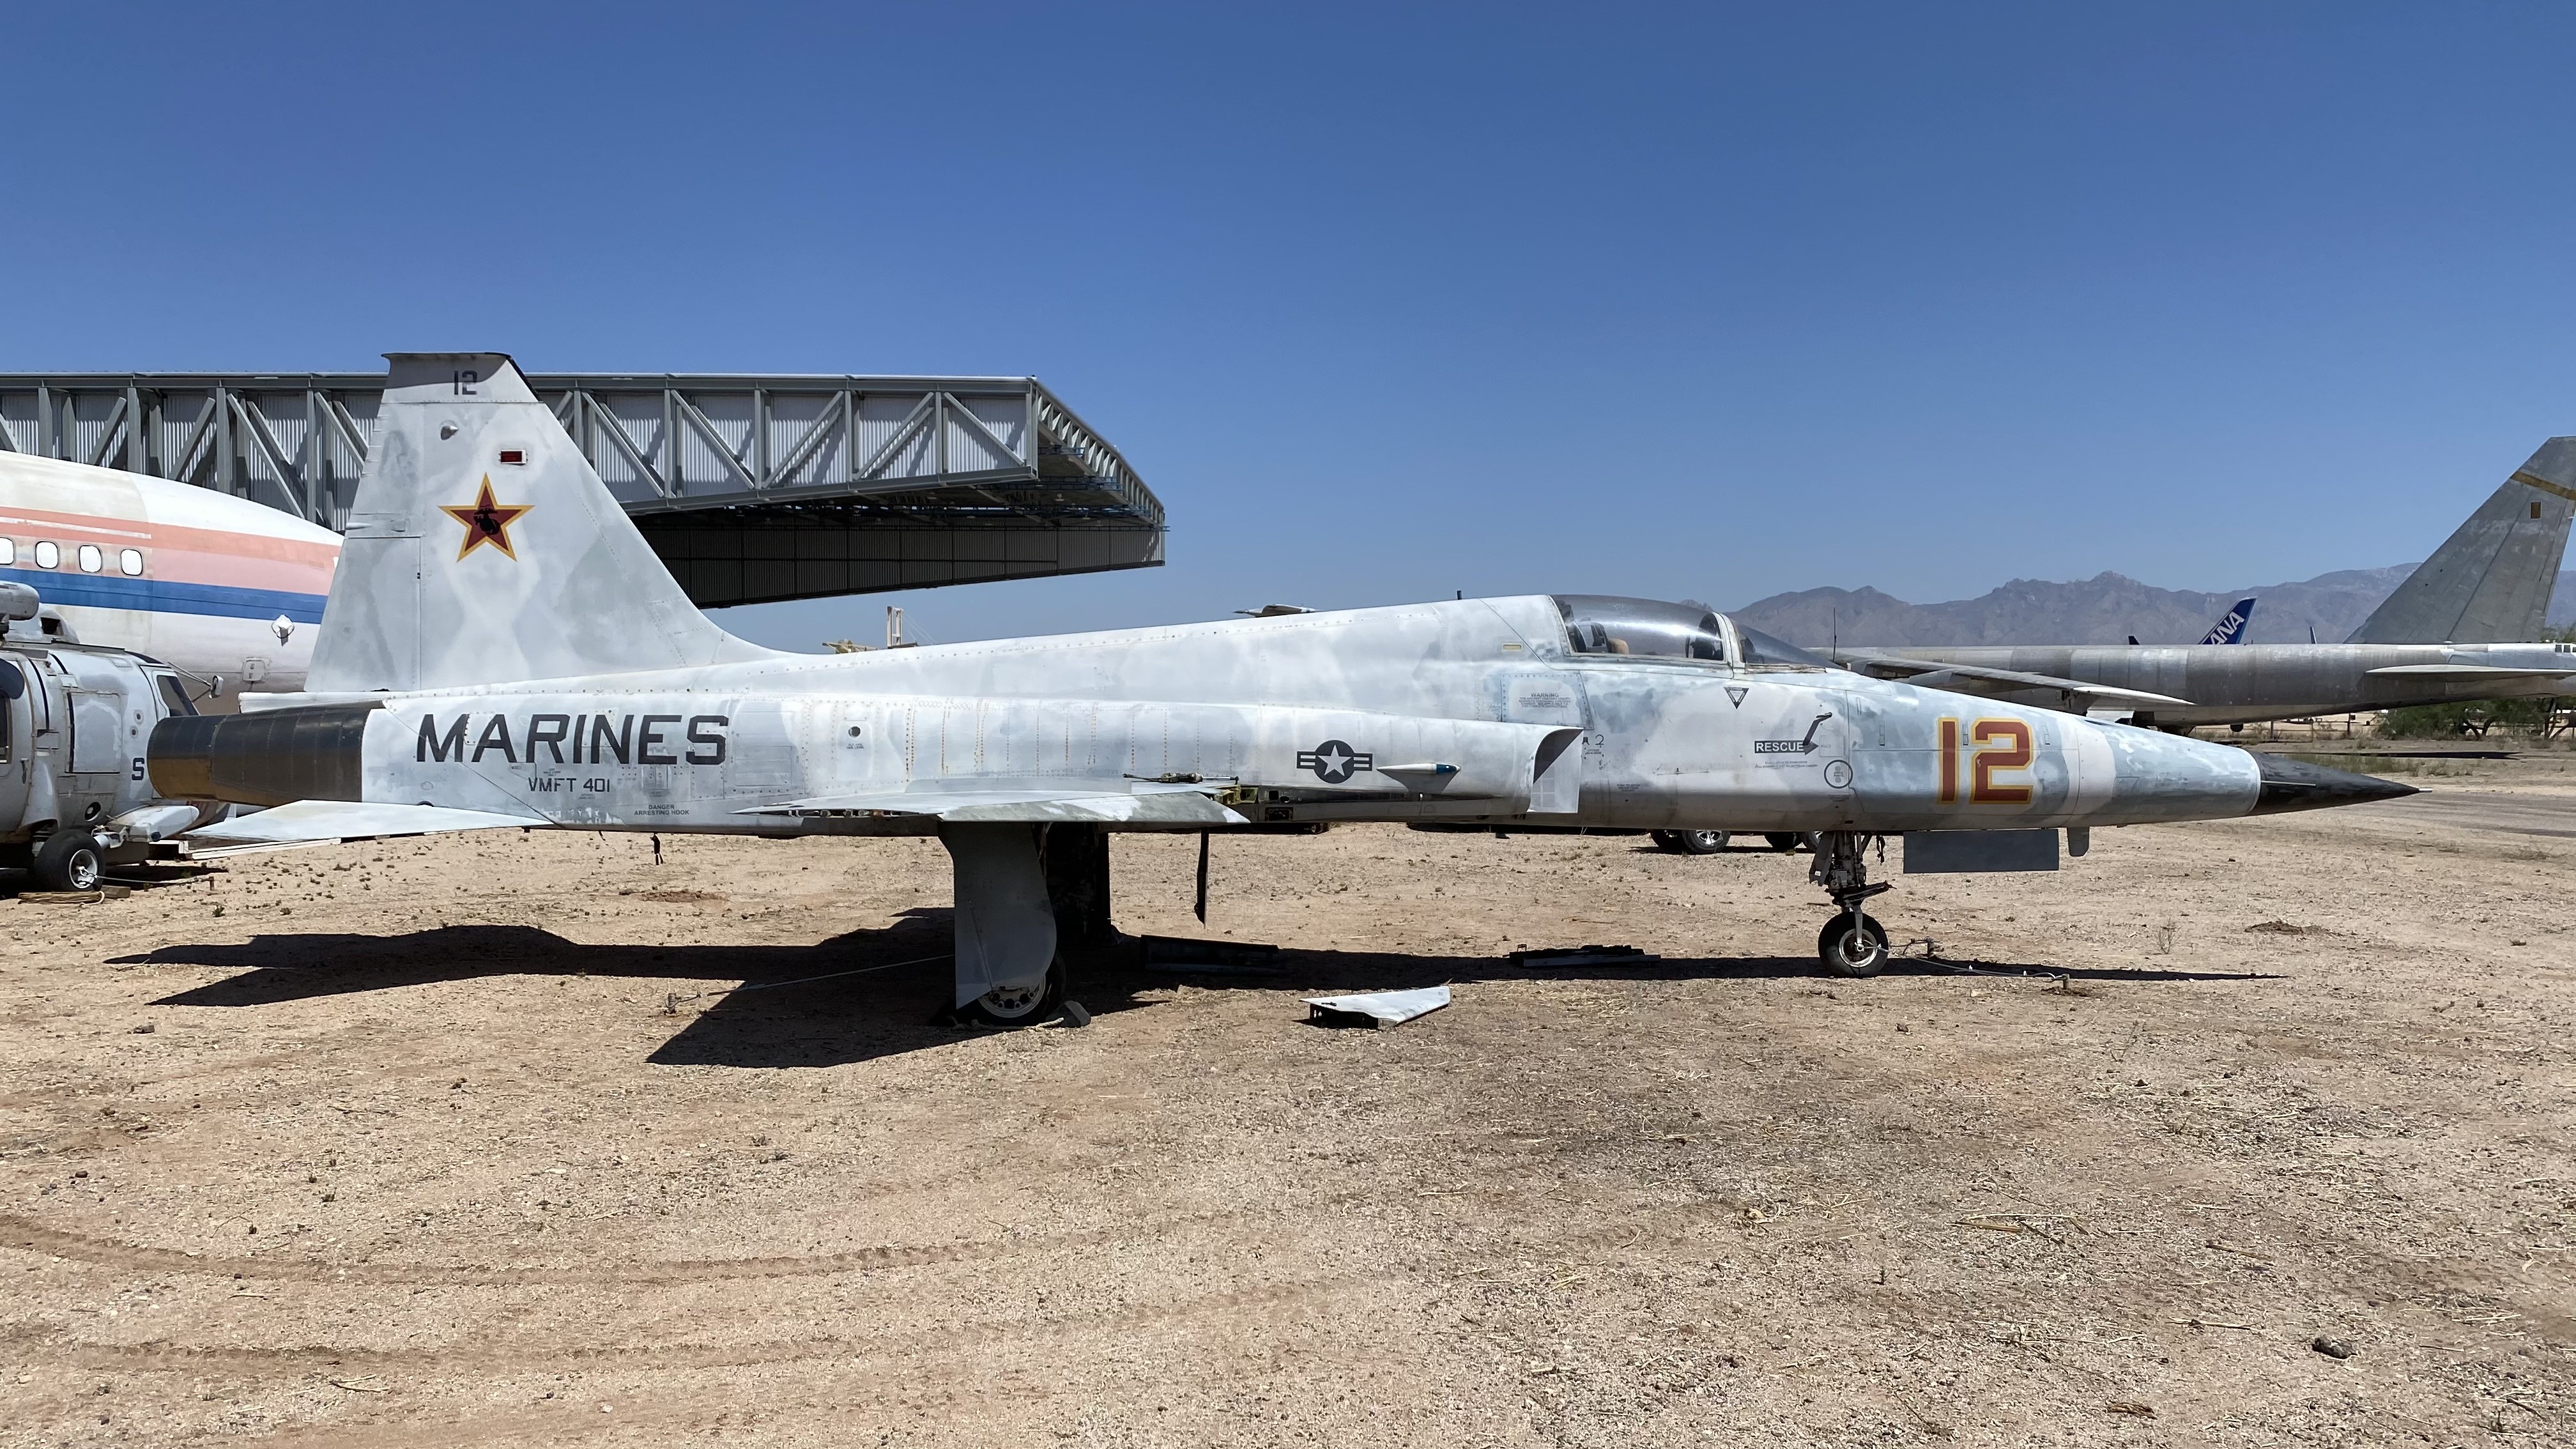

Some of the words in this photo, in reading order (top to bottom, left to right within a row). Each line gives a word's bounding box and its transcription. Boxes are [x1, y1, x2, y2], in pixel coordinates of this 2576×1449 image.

[454, 371, 477, 395] 12
[2210, 611, 2244, 644] ANA
[417, 714, 729, 765] MARINES
[1756, 742, 1804, 752] RESCUE
[1937, 717, 2034, 804] 12
[528, 777, 576, 792] VMFT
[583, 778, 610, 792] 401
